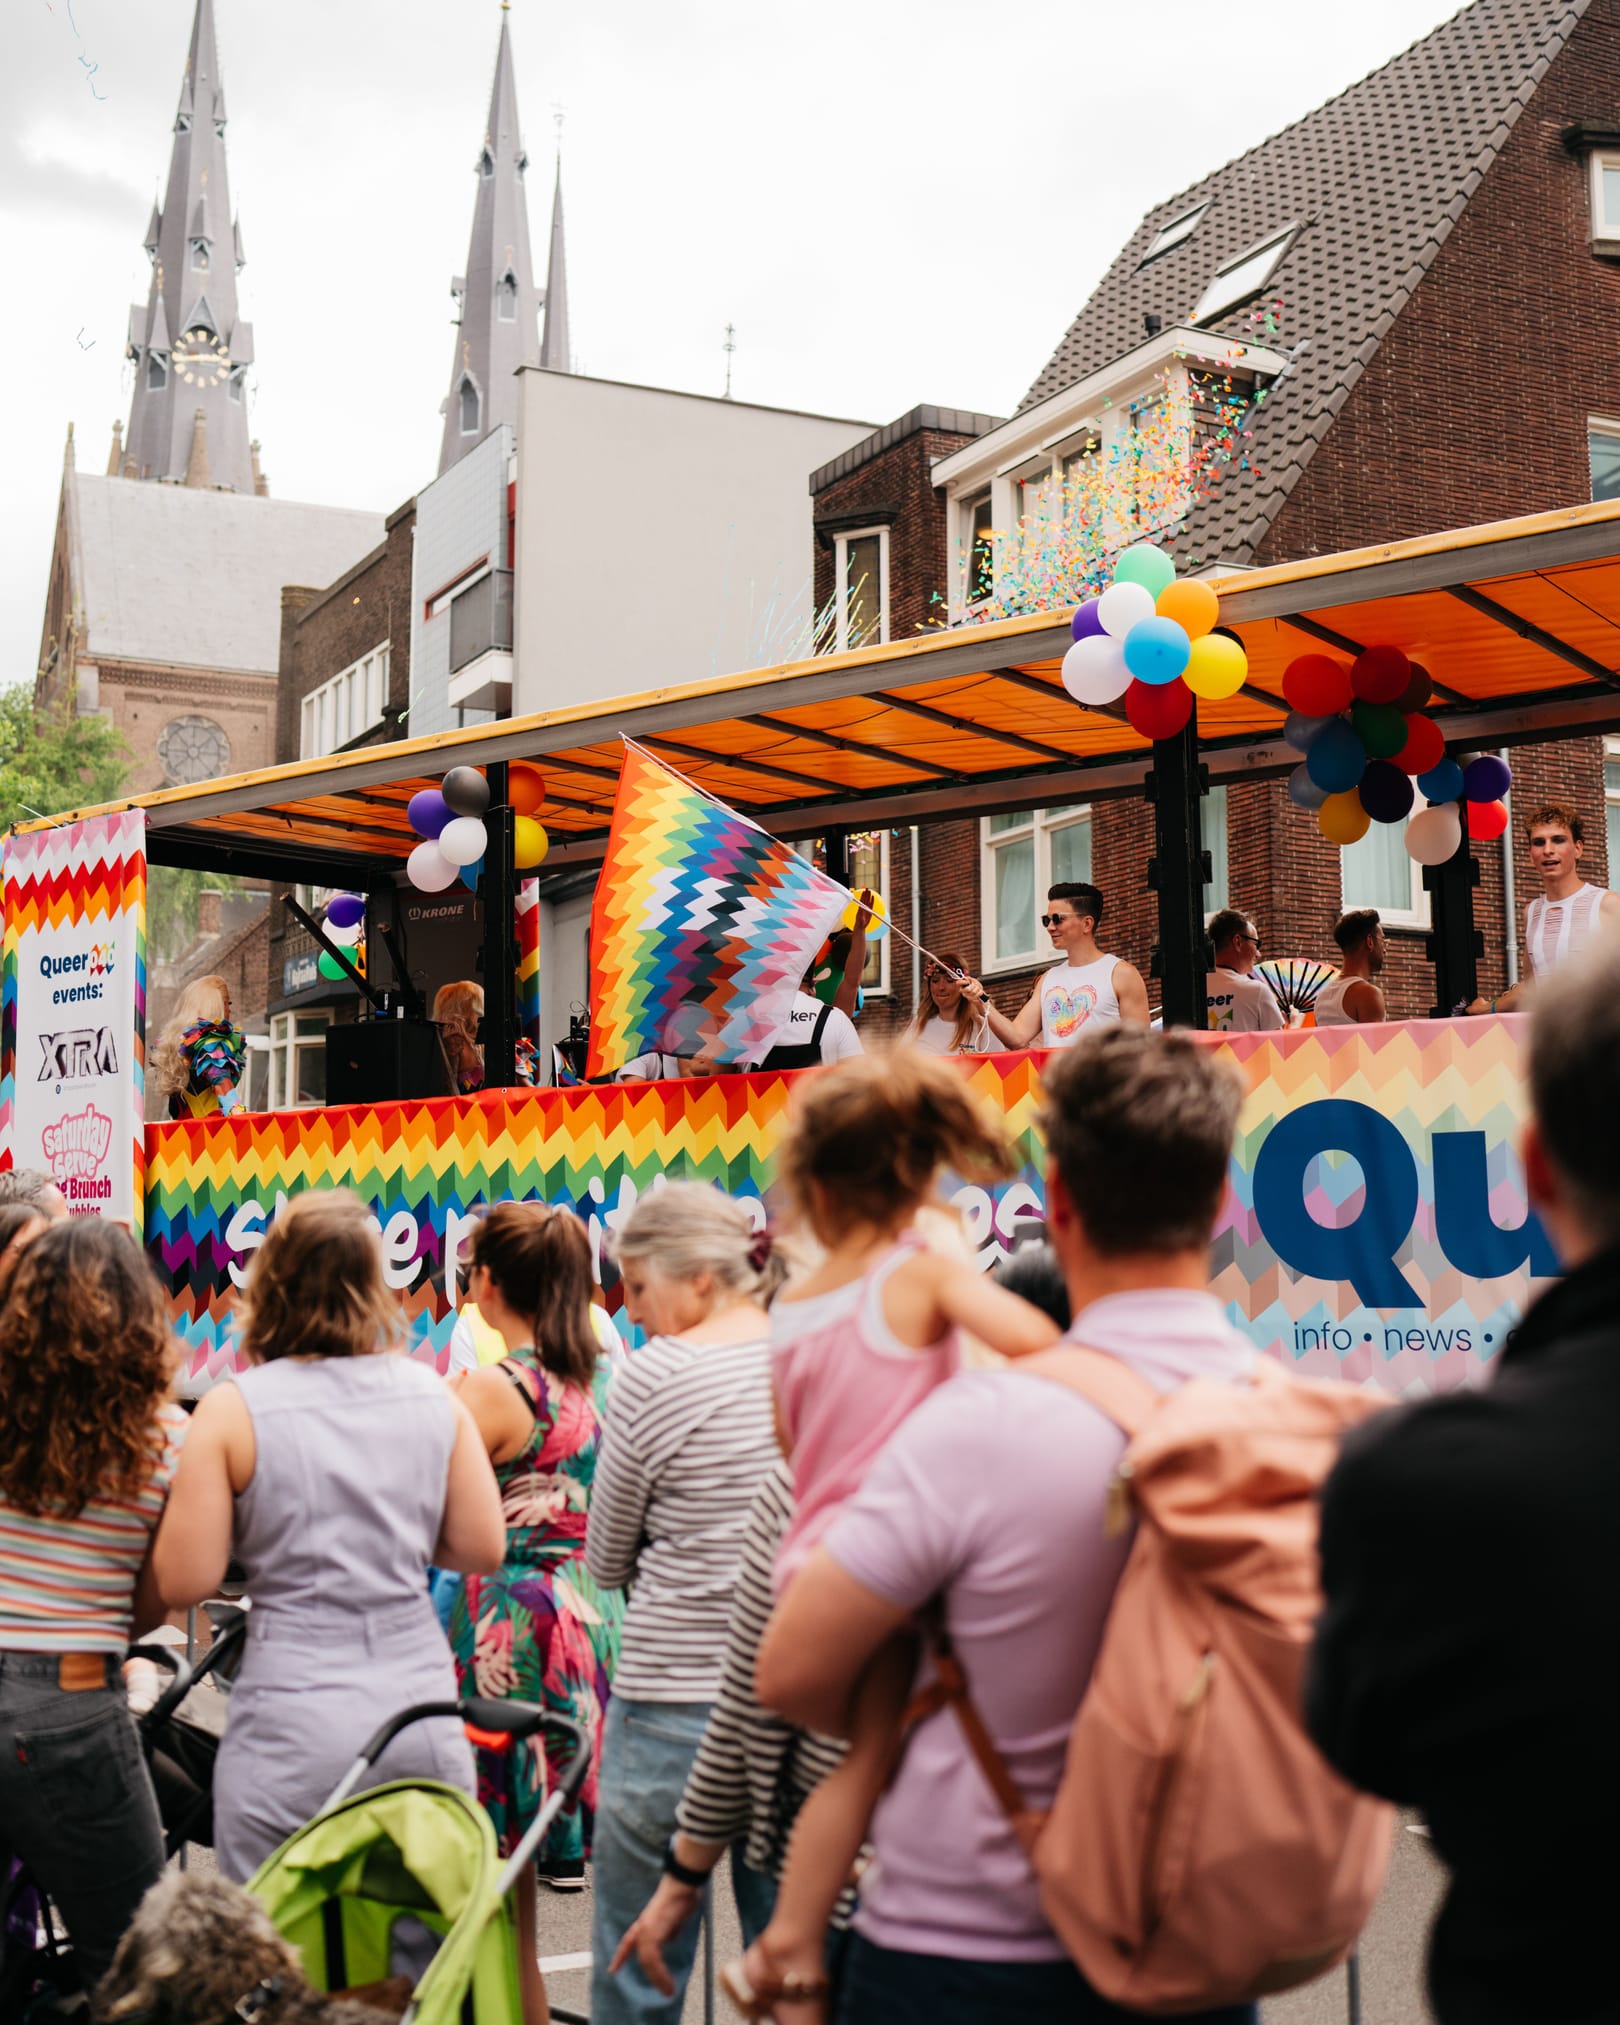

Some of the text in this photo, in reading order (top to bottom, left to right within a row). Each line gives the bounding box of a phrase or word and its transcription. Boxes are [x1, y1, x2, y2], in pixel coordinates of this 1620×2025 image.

[422, 904, 465, 919] KRONE
[40, 953, 88, 979] Queer
[53, 982, 103, 1005] events:
[37, 1026, 119, 1082] XTRA
[69, 1175, 111, 1200] Brunch
[67, 1203, 101, 1217] ubbles
[1293, 1321, 1472, 1352] info news
